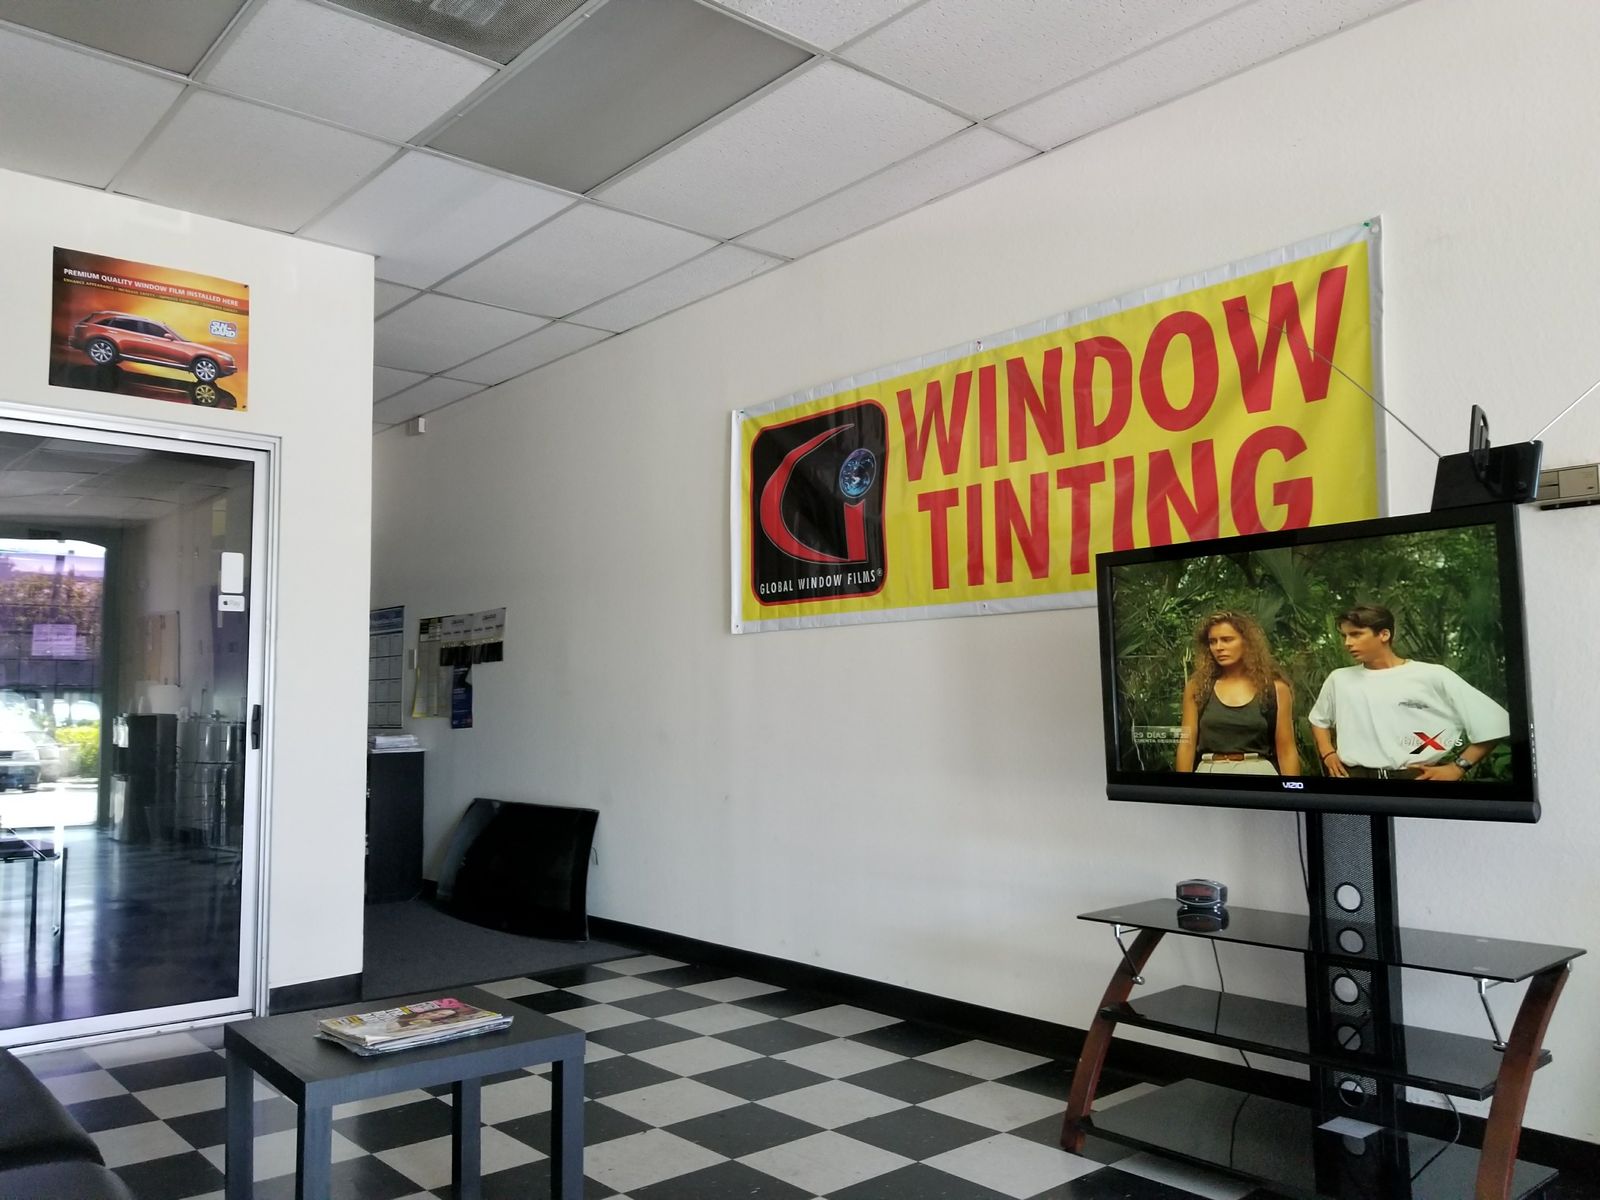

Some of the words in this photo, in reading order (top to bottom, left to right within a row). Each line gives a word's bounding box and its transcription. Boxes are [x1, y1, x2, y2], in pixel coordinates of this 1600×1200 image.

[63, 268, 99, 280] PREMIUM
[101, 275, 133, 287] QUALITY
[134, 281, 167, 293] WINDOW
[168, 287, 186, 296] FILM
[186, 289, 221, 303] INSTALLED
[222, 297, 239, 307] HERE
[896, 265, 1348, 482] WINDOW
[917, 425, 1313, 590] TINTING
[759, 580, 794, 595] GLOBAL
[798, 574, 842, 590] WINDOW
[1282, 781, 1304, 789] VIZIO
